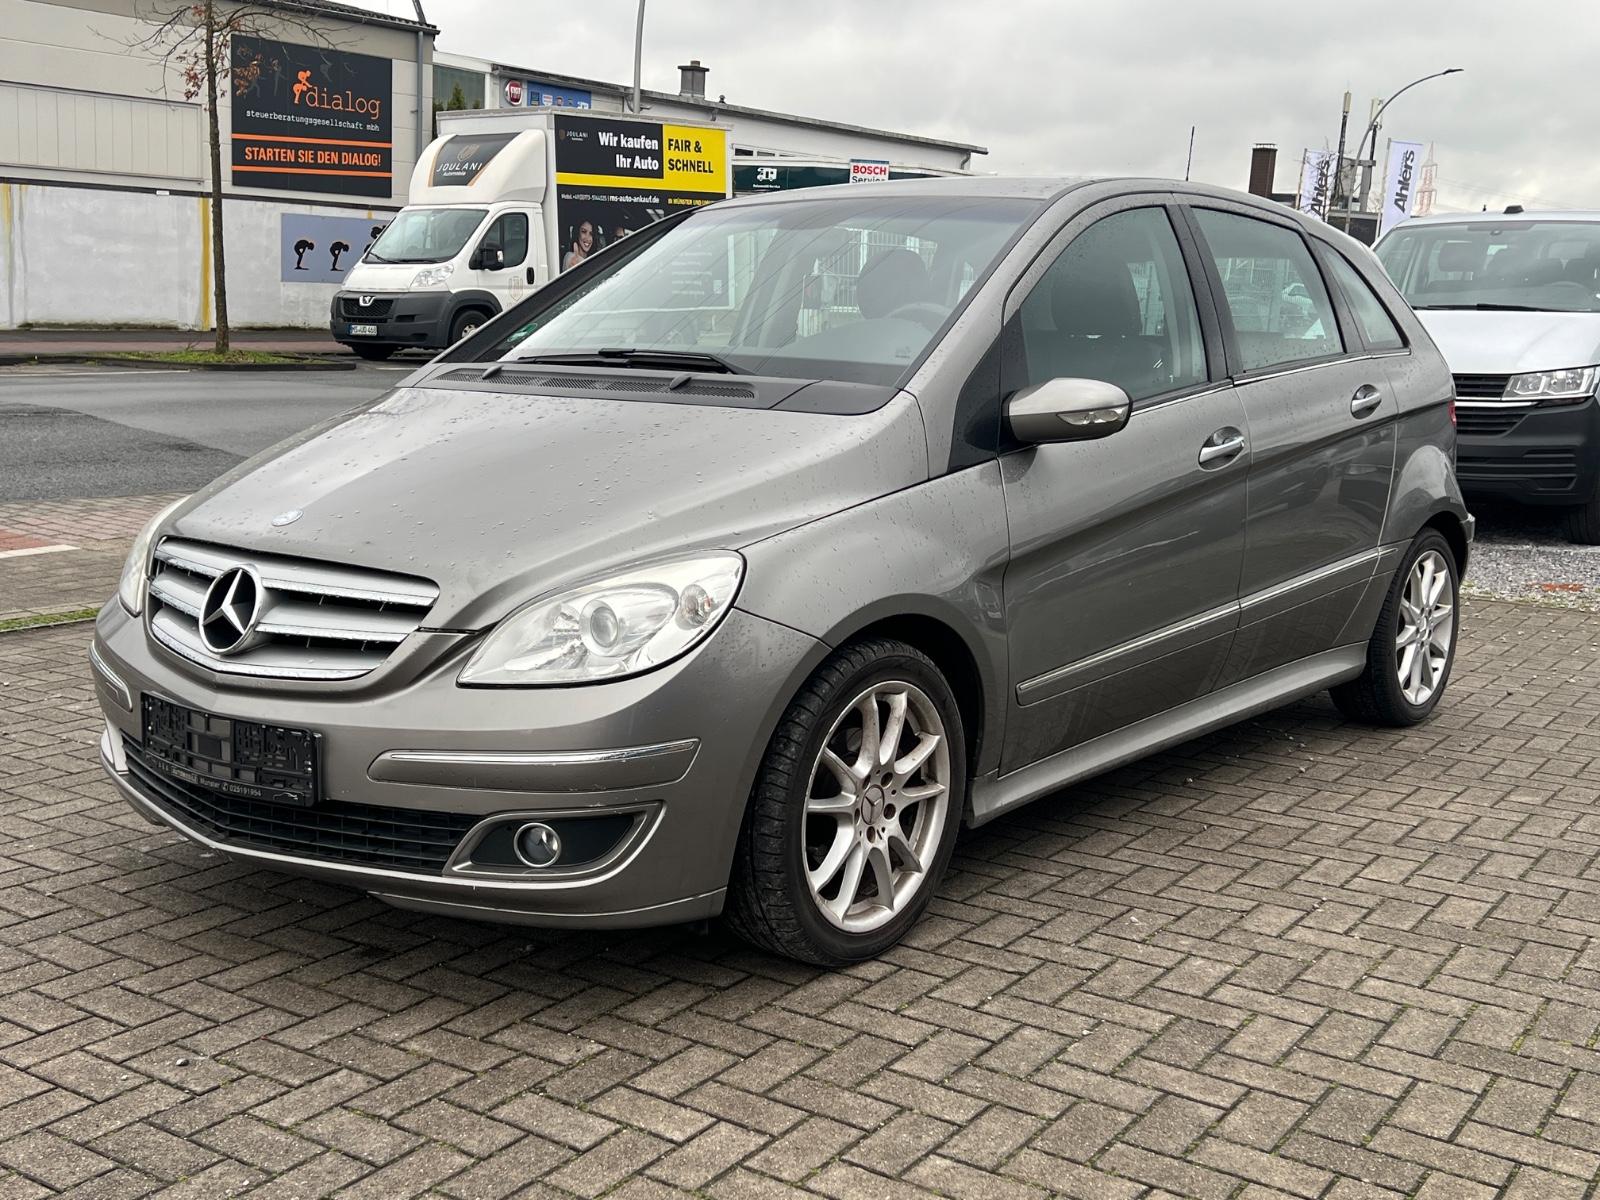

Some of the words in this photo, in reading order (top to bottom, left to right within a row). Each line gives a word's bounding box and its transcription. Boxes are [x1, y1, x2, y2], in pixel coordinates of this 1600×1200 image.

[306, 87, 381, 120] dialog
[246, 110, 363, 130] steuerberatungsgesellschaft
[366, 124, 380, 132] mbh
[598, 132, 618, 146] Wir
[620, 134, 658, 150] kaufen
[667, 138, 691, 153] FAIR
[694, 139, 702, 153] &
[245, 147, 295, 162] STARTEN
[298, 151, 314, 163] SIE
[318, 152, 338, 164] DEN
[342, 153, 381, 166] DIALOG!
[616, 154, 632, 168] Ihr
[634, 156, 659, 170] Auto
[436, 162, 482, 172] JOULANI
[668, 158, 714, 174] SCHNELL
[852, 165, 886, 176] BOSCH
[1310, 159, 1330, 217] Ahlers
[1394, 150, 1414, 214] Ahlers
[610, 196, 660, 204] ms-auto-ankauf.de
